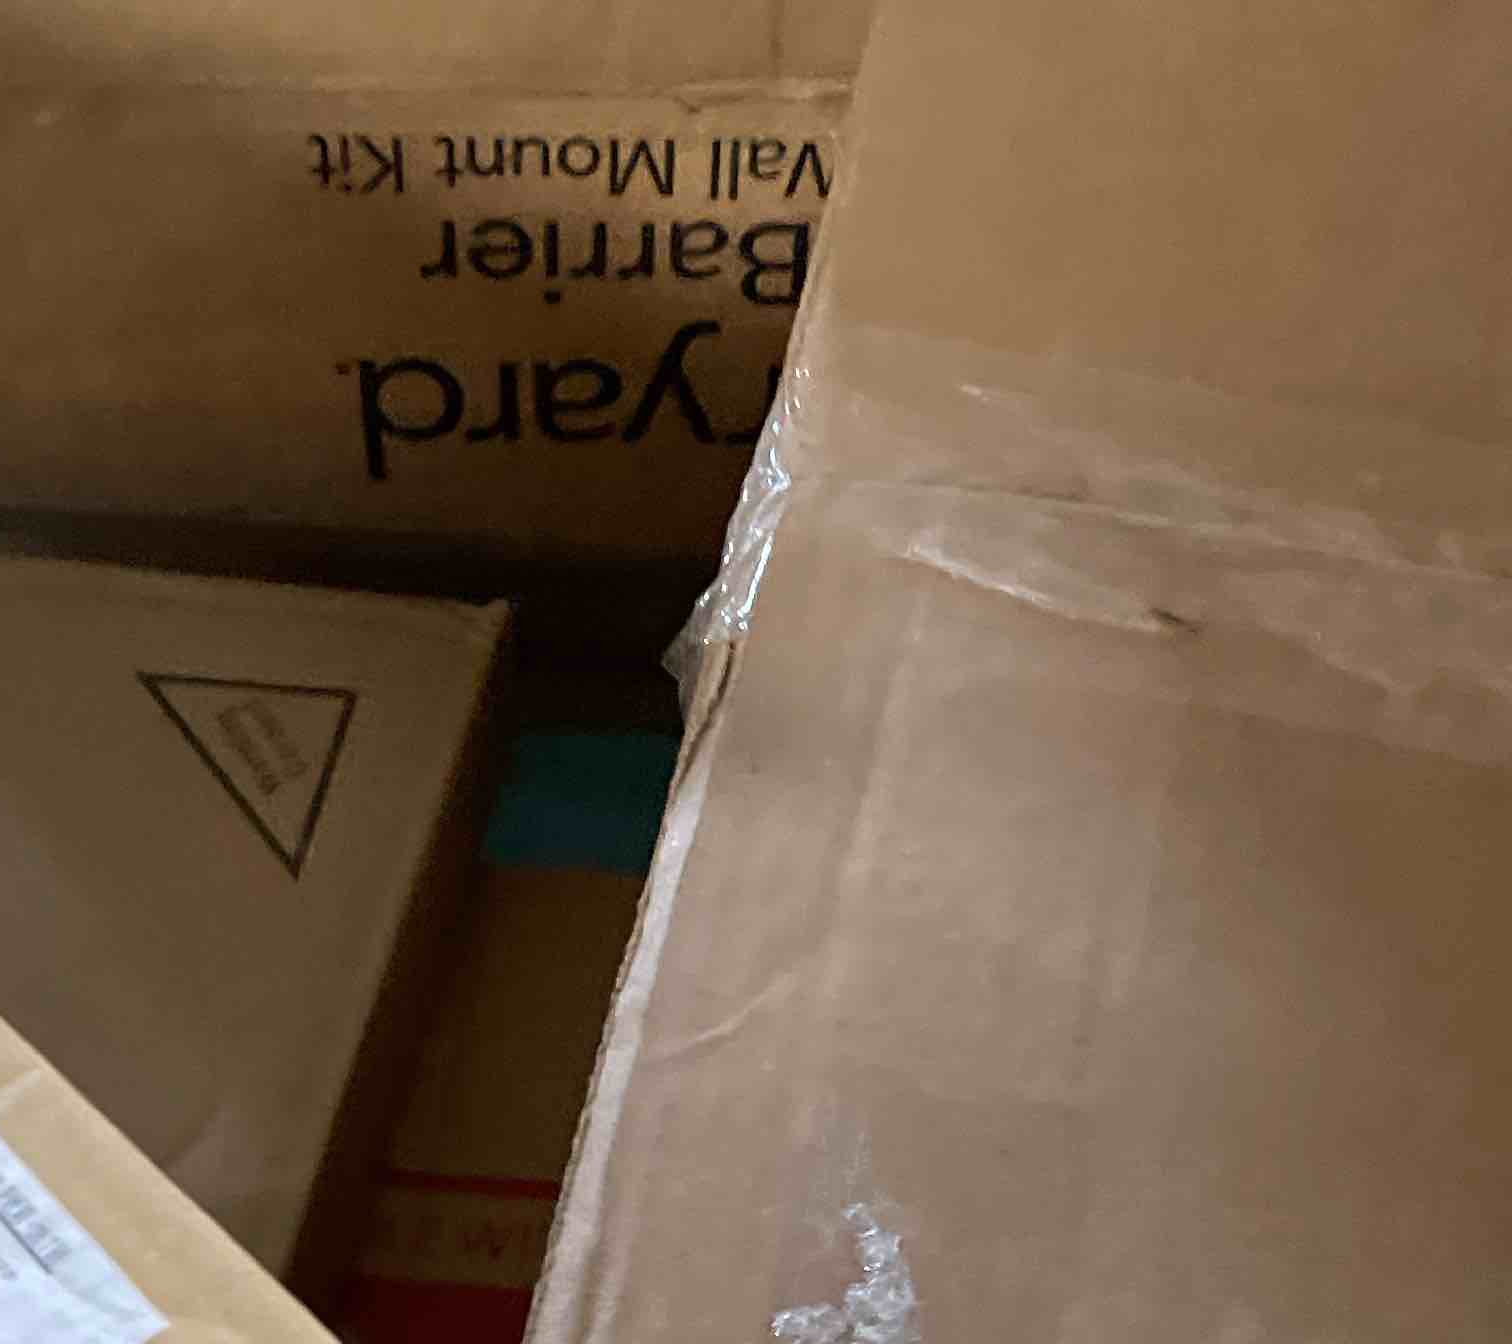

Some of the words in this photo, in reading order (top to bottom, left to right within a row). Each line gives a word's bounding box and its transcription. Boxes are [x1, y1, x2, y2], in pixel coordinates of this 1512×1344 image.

[306, 133, 407, 194] Kit
[435, 136, 677, 198] Mount
[419, 220, 813, 307] Barrier
